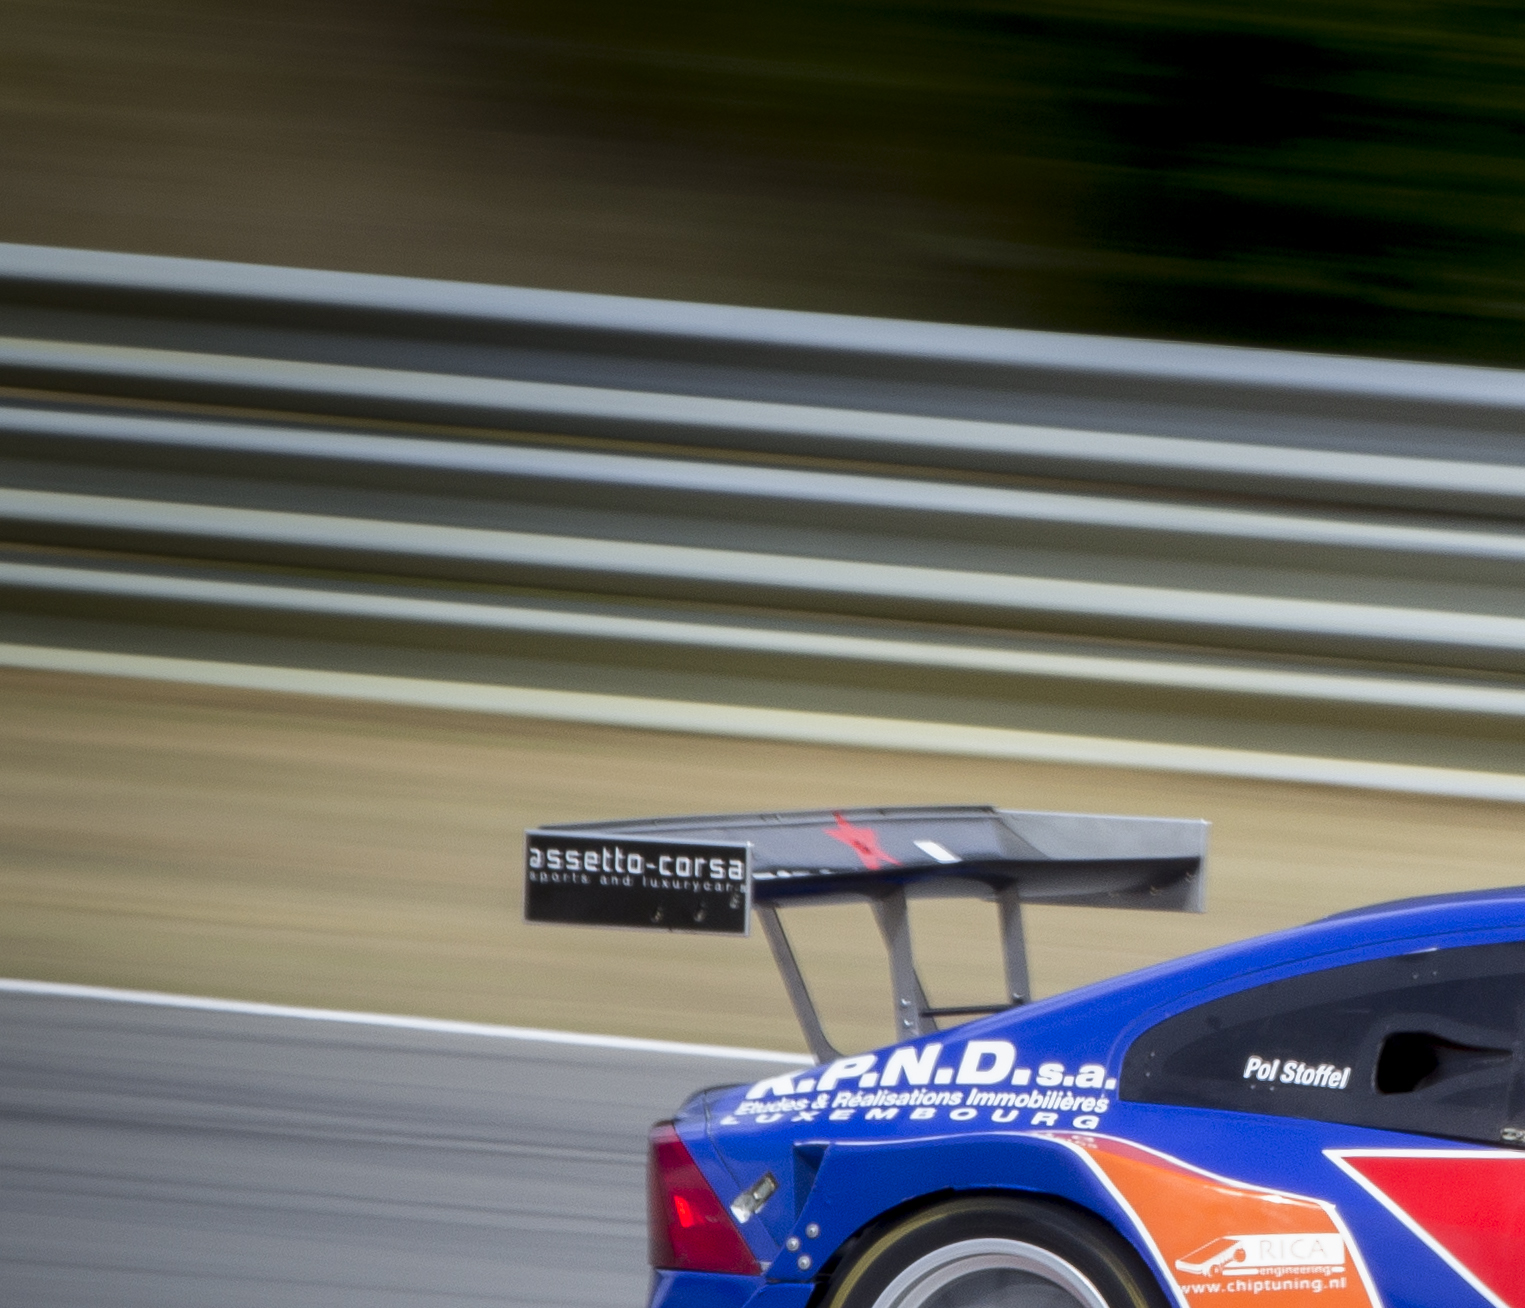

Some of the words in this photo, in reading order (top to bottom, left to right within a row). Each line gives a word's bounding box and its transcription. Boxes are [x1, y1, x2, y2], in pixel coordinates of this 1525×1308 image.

[529, 846, 745, 881] assetto-corsa
[530, 872, 589, 885] sports
[600, 874, 633, 886] and
[1243, 1055, 1281, 1082] Pol
[1280, 1060, 1351, 1090] Stoffel
[810, 1092, 830, 1110] &
[966, 1087, 1110, 1114] Immobilières
[719, 1107, 1100, 1130] LUXEMBOURG
